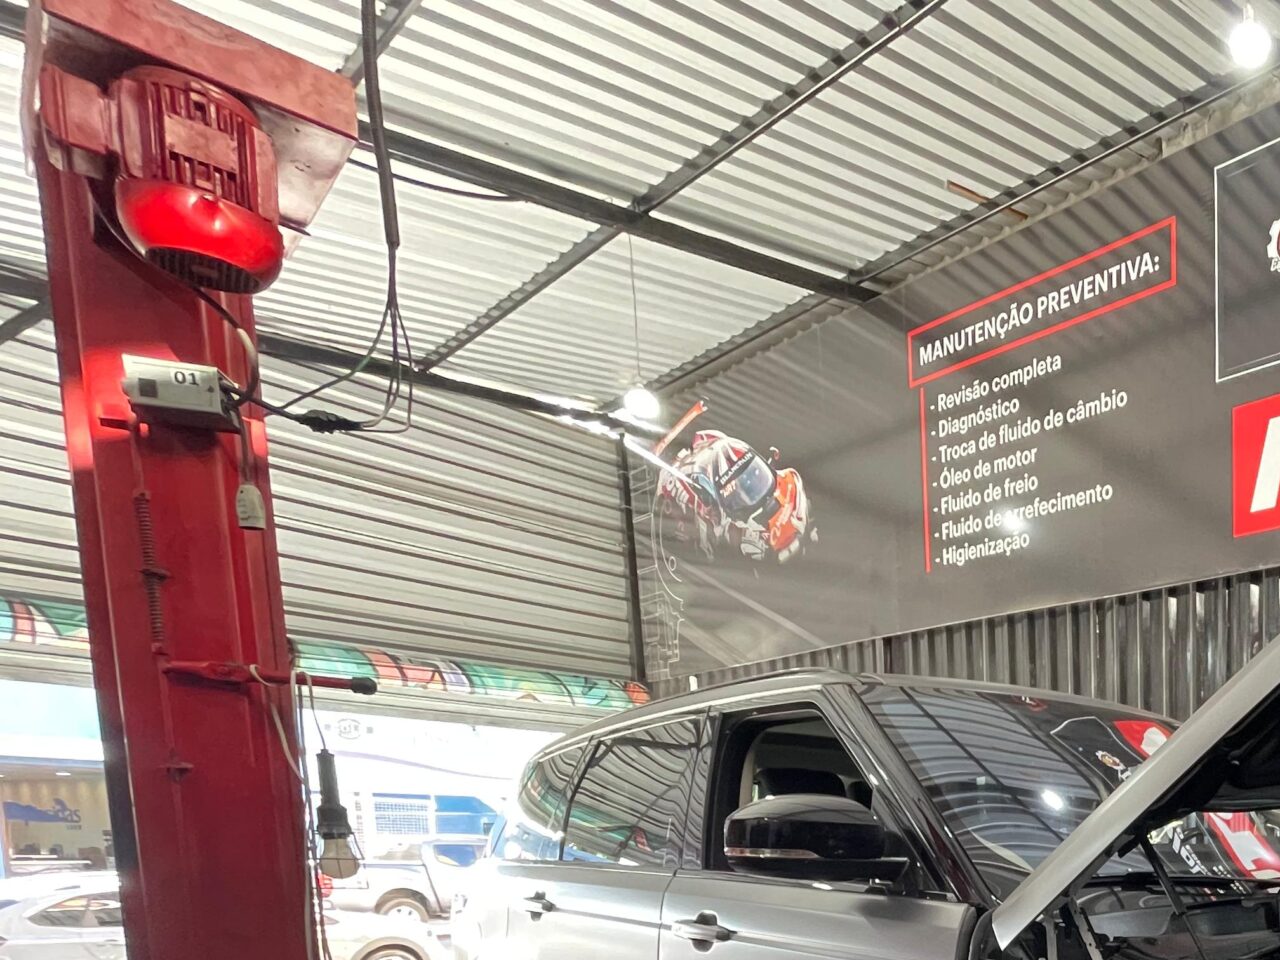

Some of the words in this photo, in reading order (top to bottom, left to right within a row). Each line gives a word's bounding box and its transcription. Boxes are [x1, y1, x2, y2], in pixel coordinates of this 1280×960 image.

[919, 303, 1033, 366] MANUTENÇÃO
[1037, 252, 1160, 319] PREVENTIVA:
[174, 371, 200, 386] 01
[937, 379, 989, 412] Revisão
[992, 354, 1062, 393] completa
[938, 398, 1020, 438] Diagnóstico
[939, 440, 976, 463] Troca
[978, 431, 997, 451] de
[999, 416, 1041, 444] fluido
[1043, 409, 1064, 431] de
[1066, 388, 1128, 423] câmbio
[940, 467, 971, 489] Óleo
[973, 459, 991, 480] de
[994, 447, 1038, 474] motor
[941, 488, 982, 515] Fluido
[983, 483, 1002, 503] de
[1004, 473, 1039, 498] freio
[942, 514, 983, 540] Fluido
[984, 510, 1002, 529] de
[942, 530, 1030, 567] Higienização
